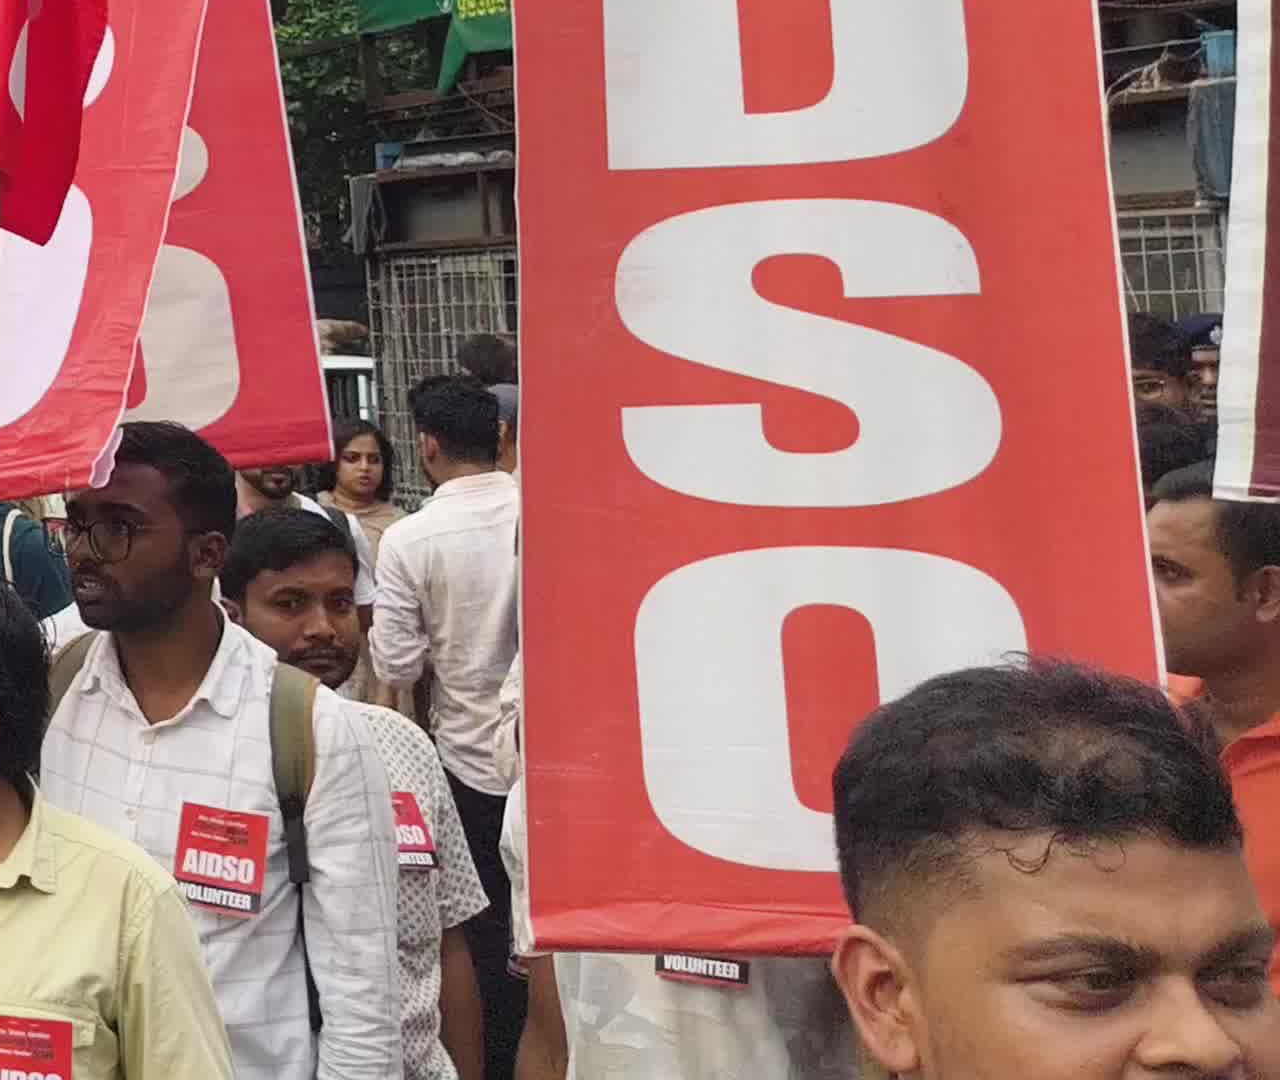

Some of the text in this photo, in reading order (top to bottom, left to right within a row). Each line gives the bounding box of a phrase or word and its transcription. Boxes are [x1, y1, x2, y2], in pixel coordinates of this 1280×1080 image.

[181, 847, 257, 886] AIDSO
[176, 880, 252, 911] VOLUNTEER
[663, 954, 740, 980] VOLUNTEER
